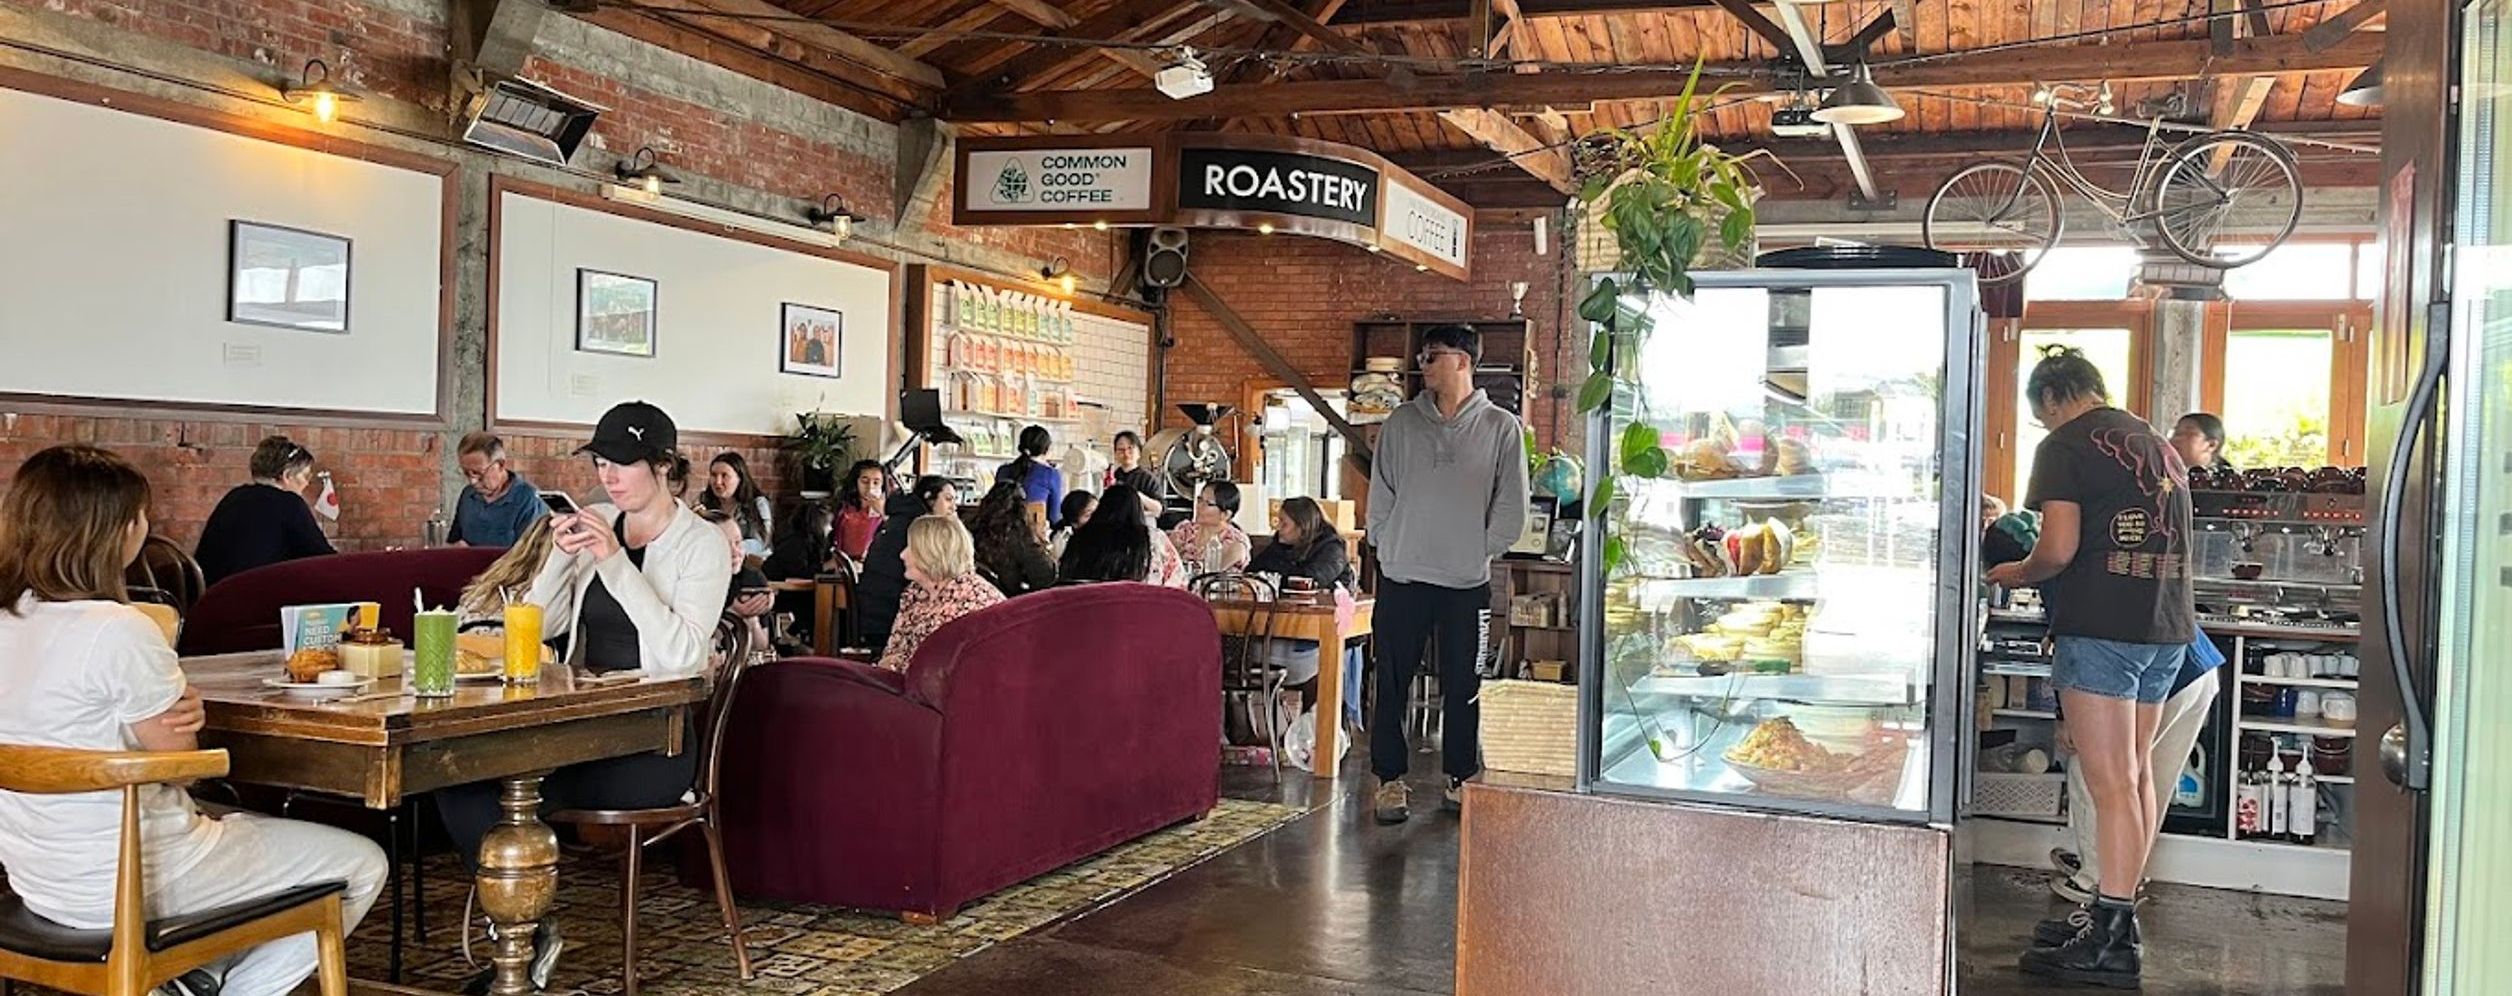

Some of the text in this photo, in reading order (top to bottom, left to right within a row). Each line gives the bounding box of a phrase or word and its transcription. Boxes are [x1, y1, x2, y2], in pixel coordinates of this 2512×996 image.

[1041, 156, 1127, 169] COMMON
[1205, 164, 1367, 212] ROASTERY
[1040, 190, 1113, 203] COFFEE
[1408, 210, 1446, 252] COFFEE
[305, 625, 330, 636] NEED
